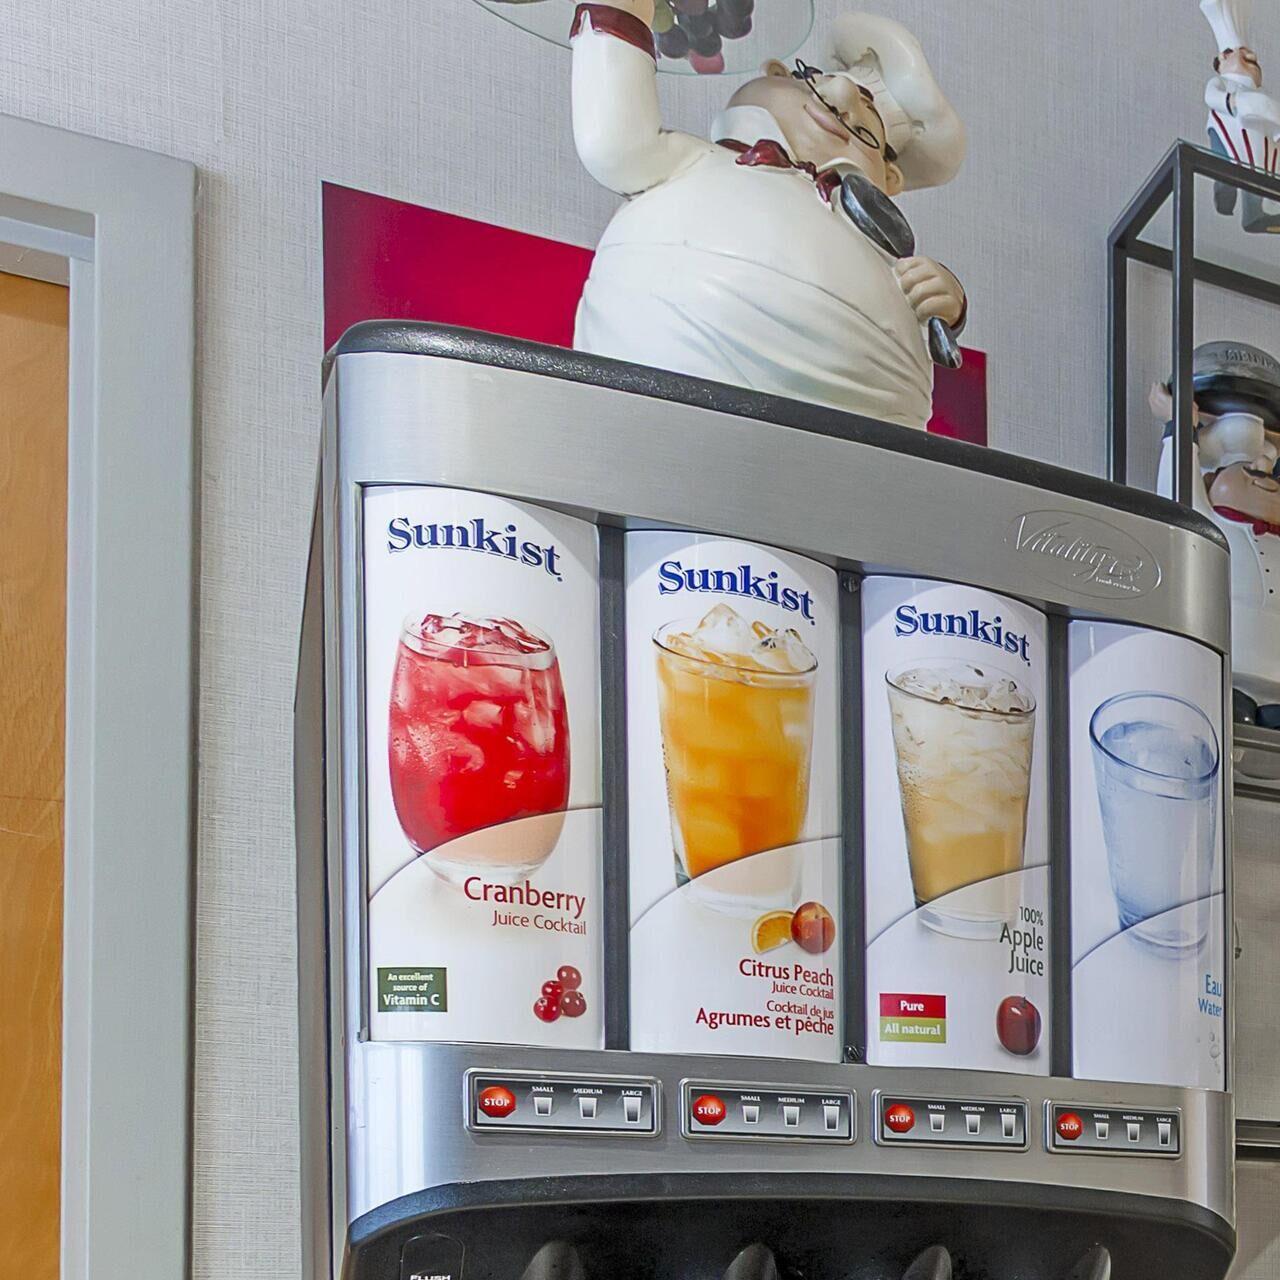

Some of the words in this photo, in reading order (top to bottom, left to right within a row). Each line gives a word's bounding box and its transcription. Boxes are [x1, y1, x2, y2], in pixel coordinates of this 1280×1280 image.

[387, 517, 562, 577] Sunkist
[658, 560, 815, 620] Sunkist
[895, 604, 1031, 662] Sunkist
[463, 876, 586, 919] Cranberry
[492, 910, 529, 927] Juice
[533, 914, 587, 935] Cocktail
[1020, 906, 1044, 926] 100%
[999, 923, 1044, 953] Apple
[739, 958, 790, 980] Citrus
[794, 964, 834, 986] Peach
[1008, 951, 1044, 976] Juice
[387, 973, 397, 981] An
[399, 972, 434, 981] excellent
[1205, 974, 1222, 997] Eau
[418, 983, 428, 991] of
[771, 981, 797, 994] Juice
[799, 984, 834, 1000] Cocktail
[383, 993, 428, 1006] Vitamin
[430, 994, 440, 1006] C
[901, 1000, 924, 1011] Pure
[1198, 997, 1222, 1017] Water
[766, 1000, 808, 1016] Cocktail
[810, 1005, 821, 1016] de
[822, 1008, 834, 1021] jus
[696, 1007, 771, 1030] Agrumes
[775, 1015, 792, 1030] et
[795, 1016, 834, 1036] pêche
[885, 1023, 899, 1033] All
[902, 1024, 941, 1036] natural
[484, 1098, 510, 1106] STOP
[697, 1107, 721, 1115] STOP
[889, 1115, 911, 1123] STOP
[1060, 1123, 1079, 1131] STOP
